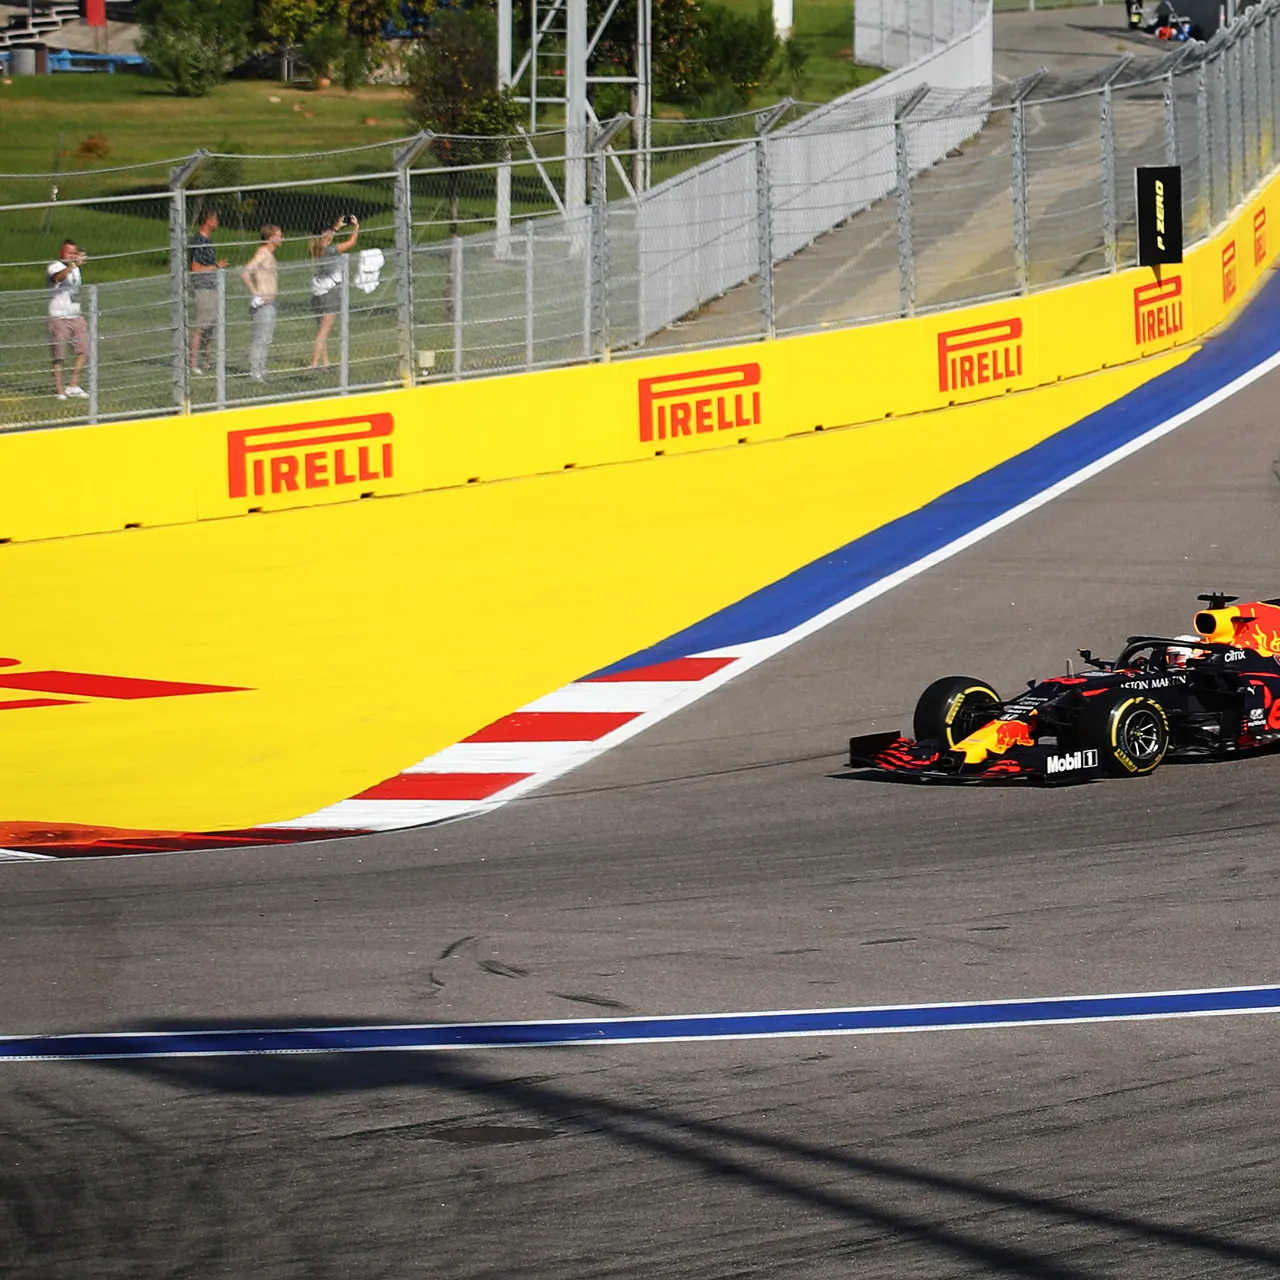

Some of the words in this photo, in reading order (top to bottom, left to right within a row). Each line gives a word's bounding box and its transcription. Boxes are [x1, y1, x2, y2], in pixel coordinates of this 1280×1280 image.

[1155, 180, 1165, 235] ZERO
[1157, 236, 1166, 251] P
[1133, 275, 1183, 345] PIRELLI
[937, 317, 1022, 392] PIRELLI
[638, 363, 761, 443] PIRELLI
[228, 412, 394, 498] PIRELLI
[1120, 679, 1149, 690] STON
[1046, 751, 1082, 774] Mobil
[1084, 750, 1097, 768] 1
